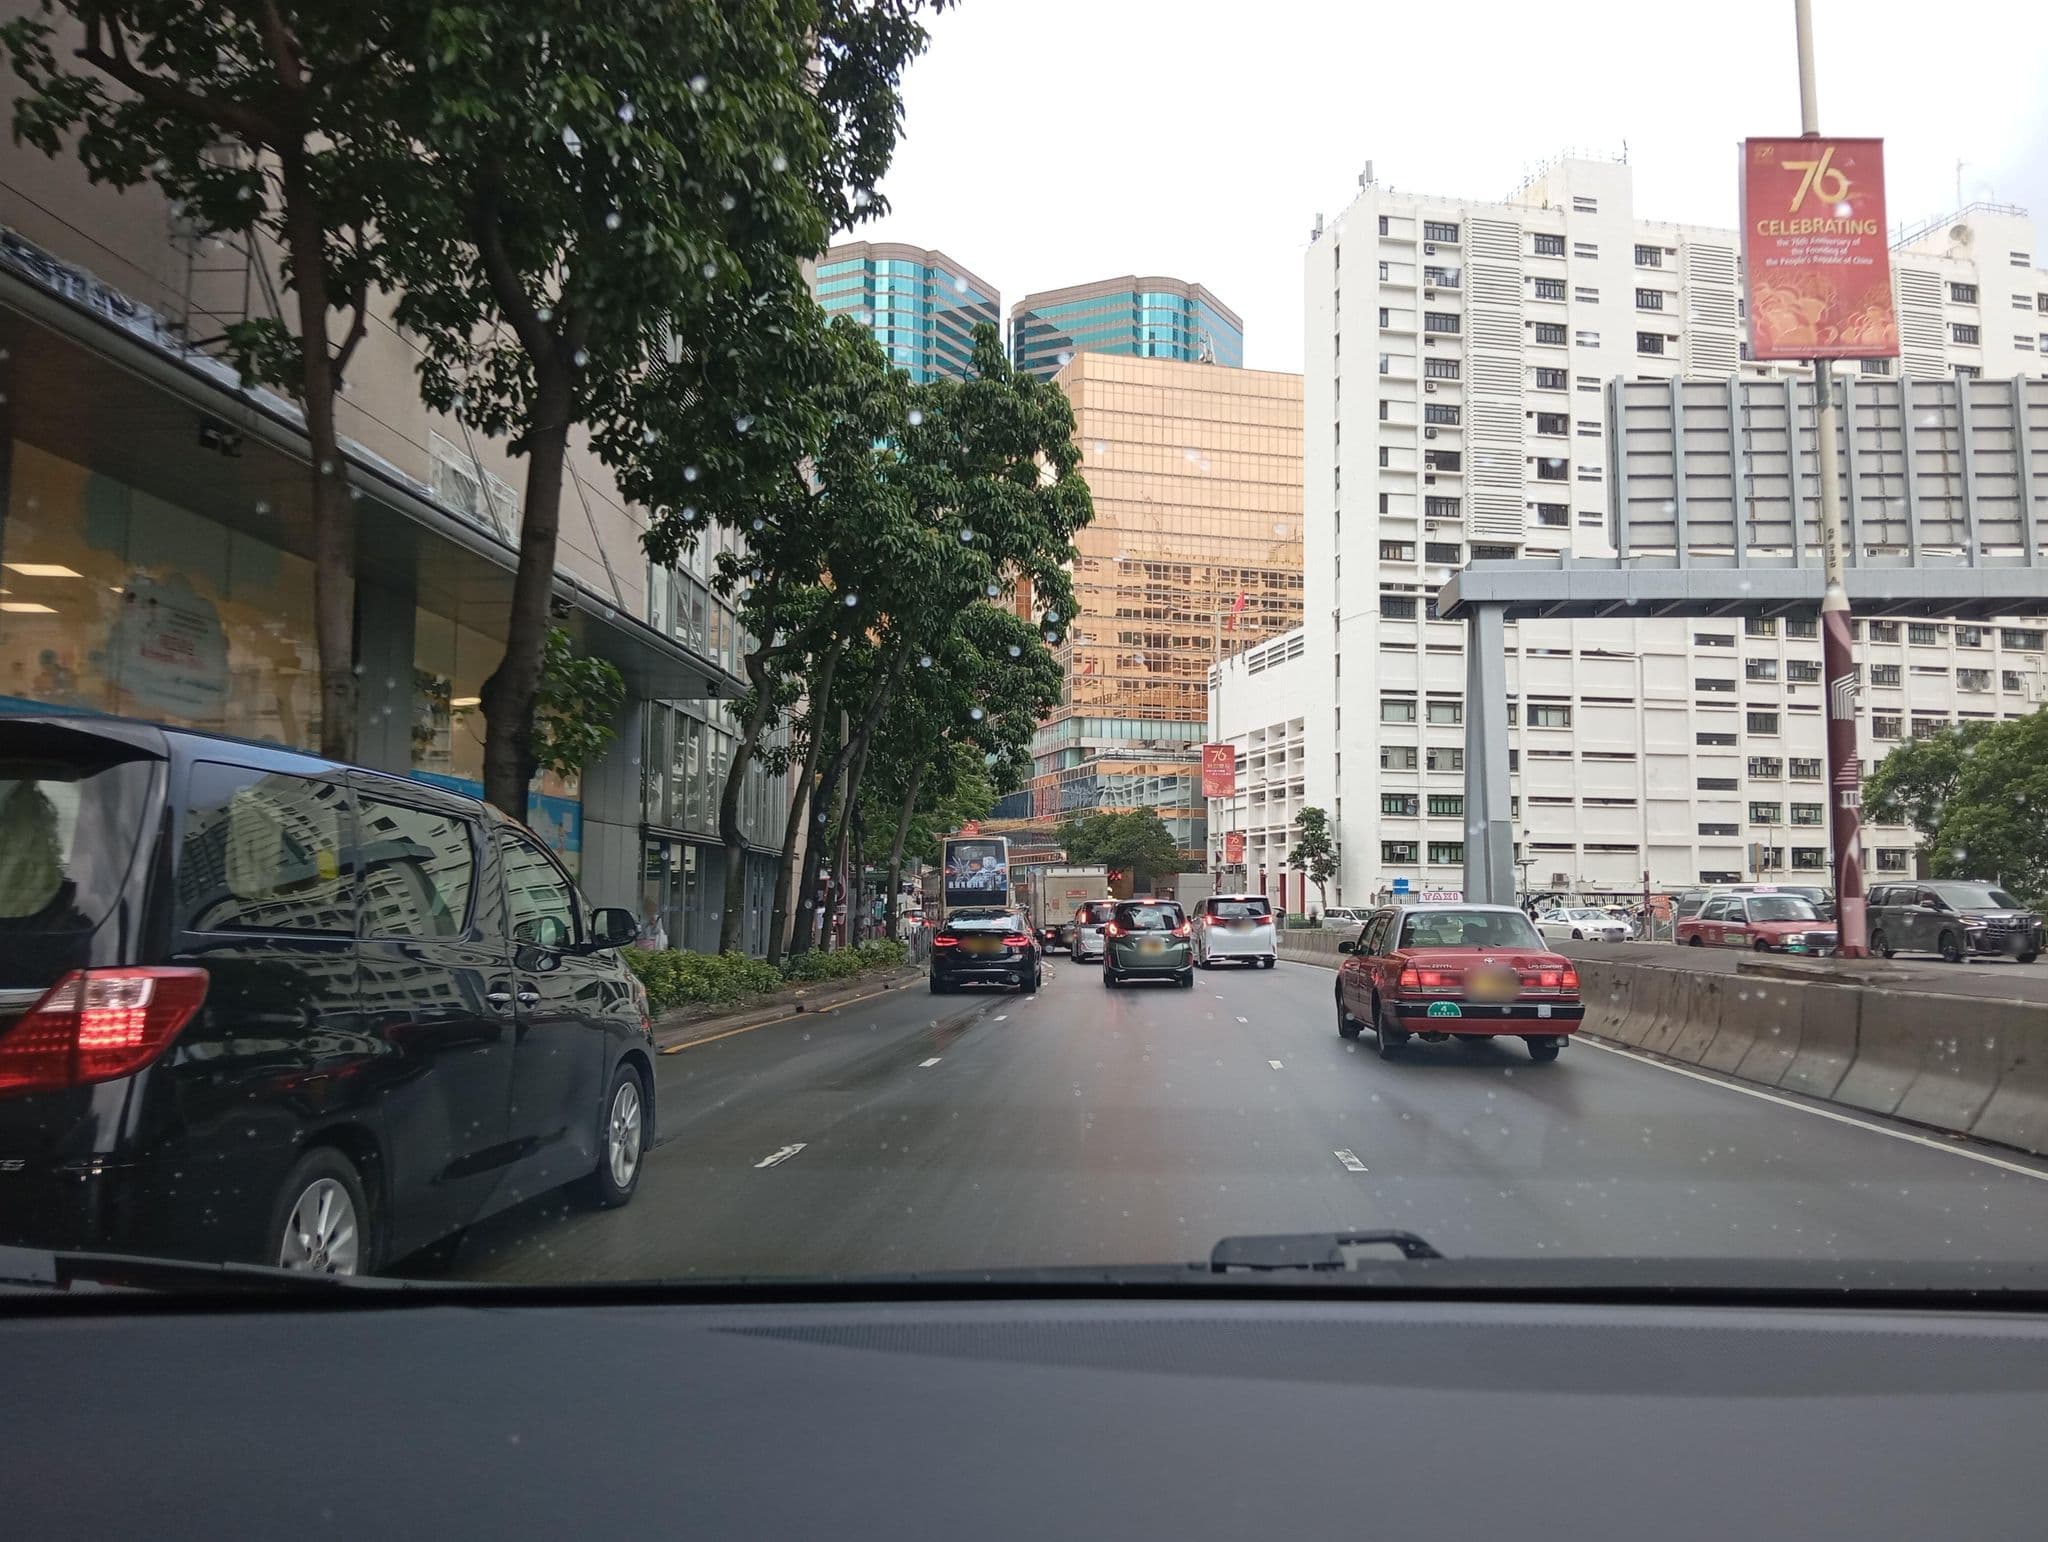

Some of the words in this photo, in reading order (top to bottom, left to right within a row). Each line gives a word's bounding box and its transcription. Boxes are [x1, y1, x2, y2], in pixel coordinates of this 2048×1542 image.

[1780, 146, 1850, 213] 76
[1757, 218, 1878, 236] CELEBRATING
[1211, 748, 1227, 763] 76
[1423, 892, 1459, 901] TAXI
